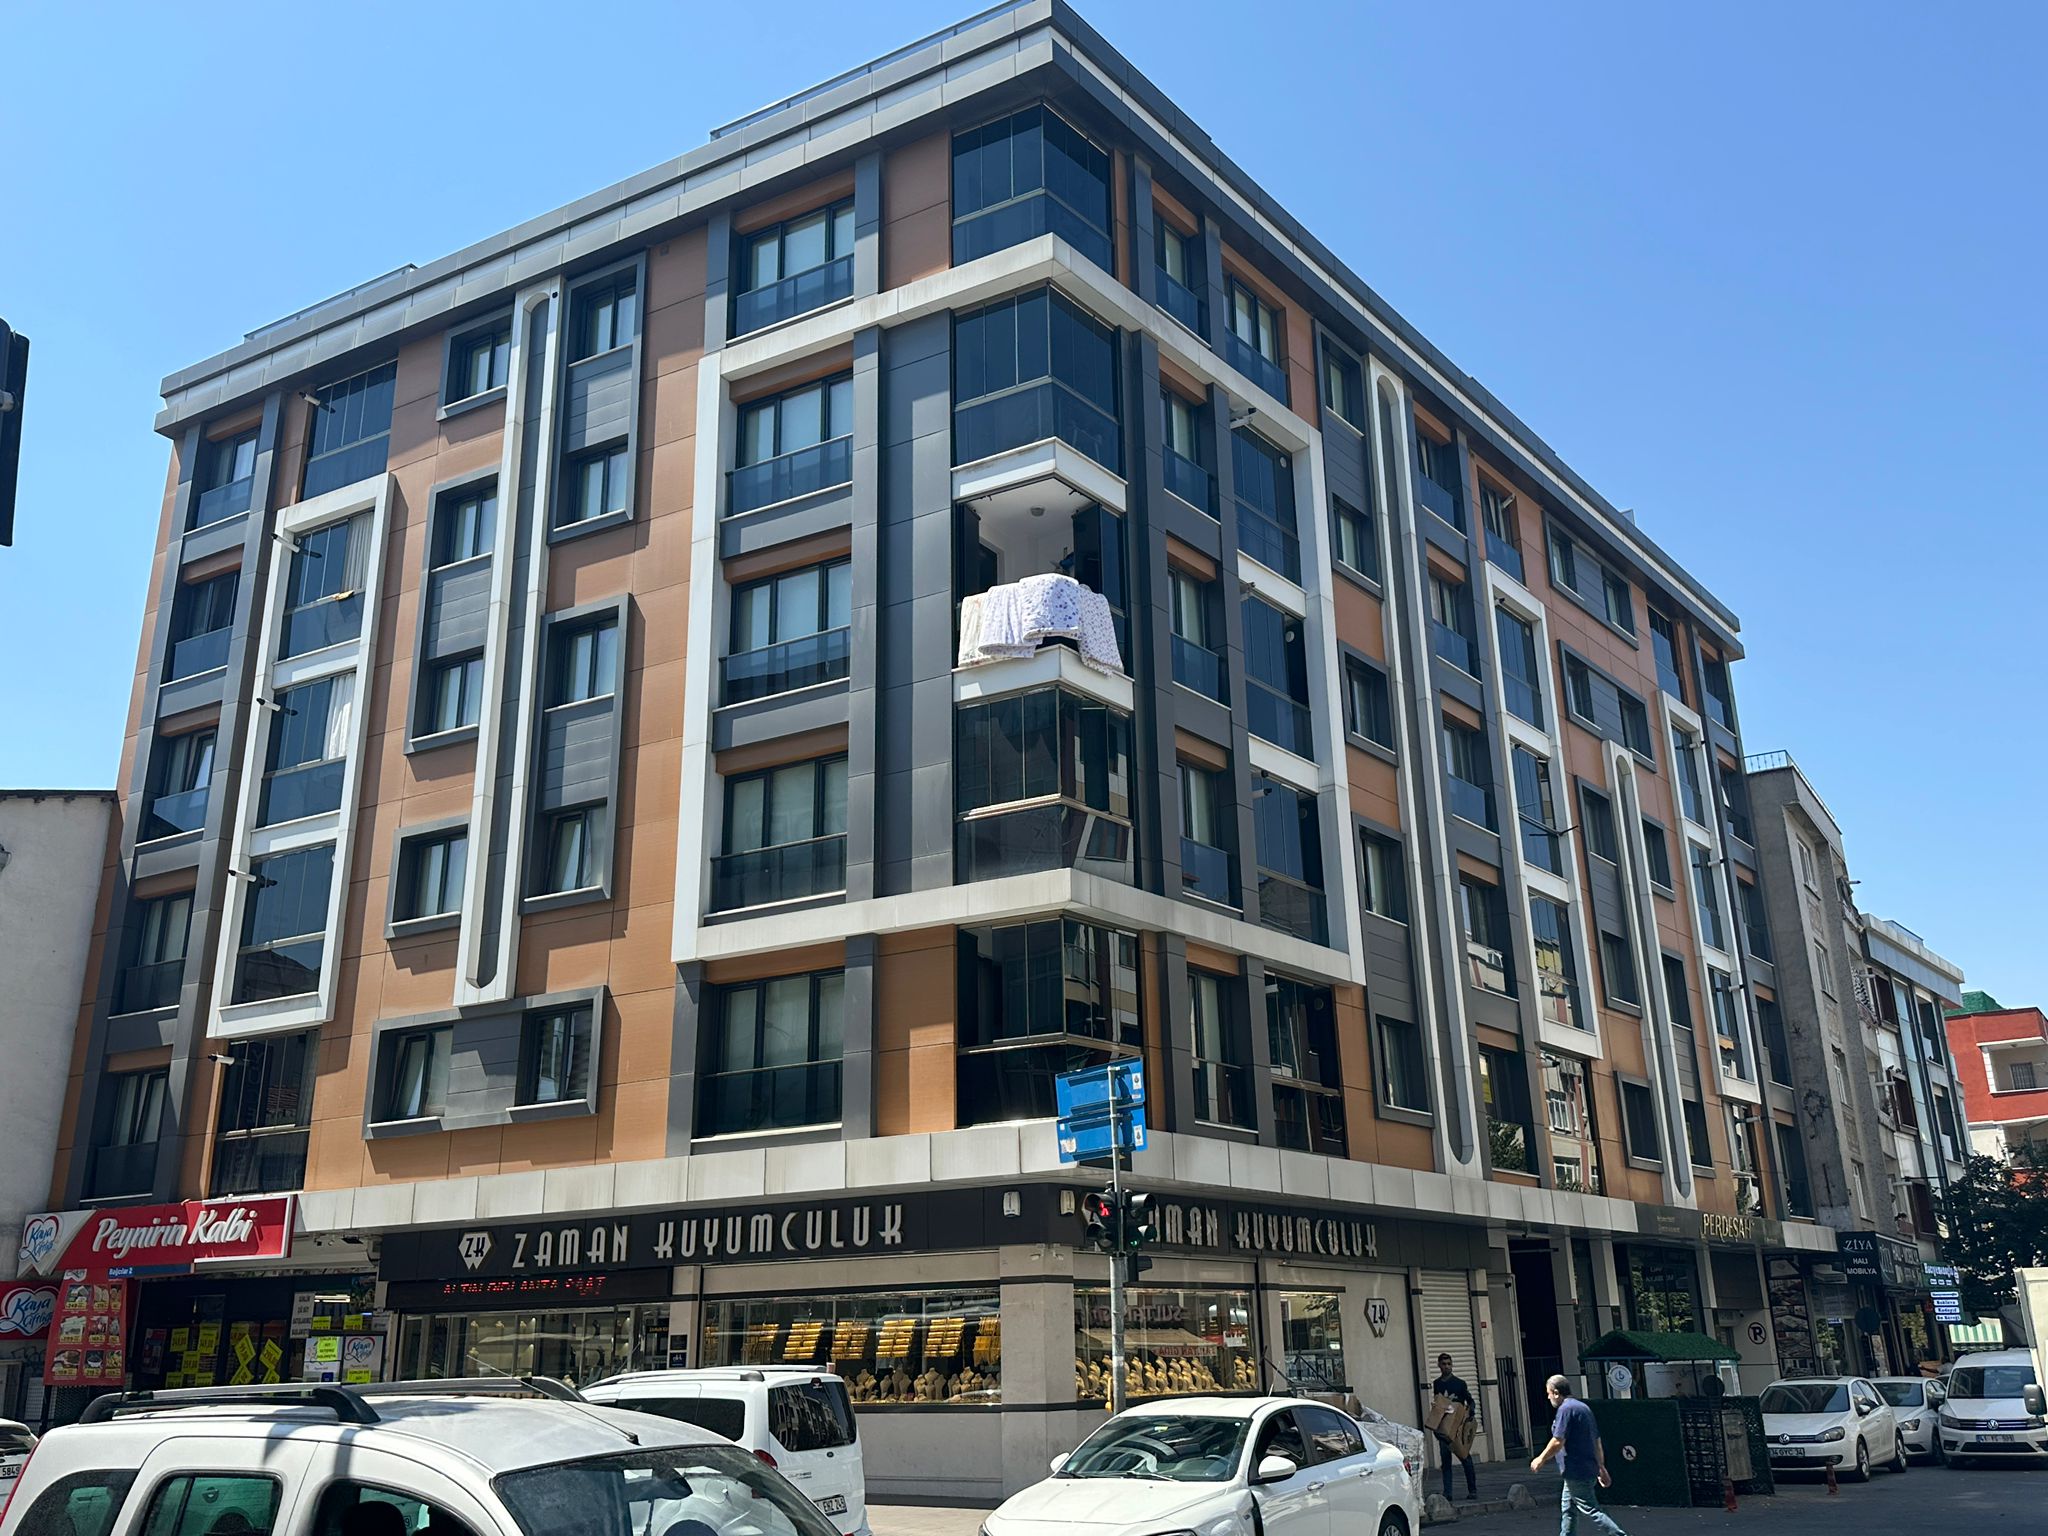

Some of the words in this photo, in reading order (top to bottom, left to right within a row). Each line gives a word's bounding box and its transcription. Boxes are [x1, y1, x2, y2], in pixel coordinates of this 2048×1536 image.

[28, 1224, 53, 1242] Kaya
[93, 1218, 188, 1259] Peynirin
[188, 1207, 258, 1245] Kalbi
[512, 1223, 628, 1268] ZAMAN
[653, 1204, 902, 1260] KUYUMCULUK
[1148, 1203, 1218, 1248] AMAN
[1234, 1211, 1378, 1258] KUYUMCULUK
[463, 1236, 486, 1258] ZK
[1843, 1239, 1873, 1252] ZİYA
[1853, 1257, 1869, 1265] HALI
[12, 1296, 51, 1320] Kaya
[1372, 1304, 1386, 1324] ZK
